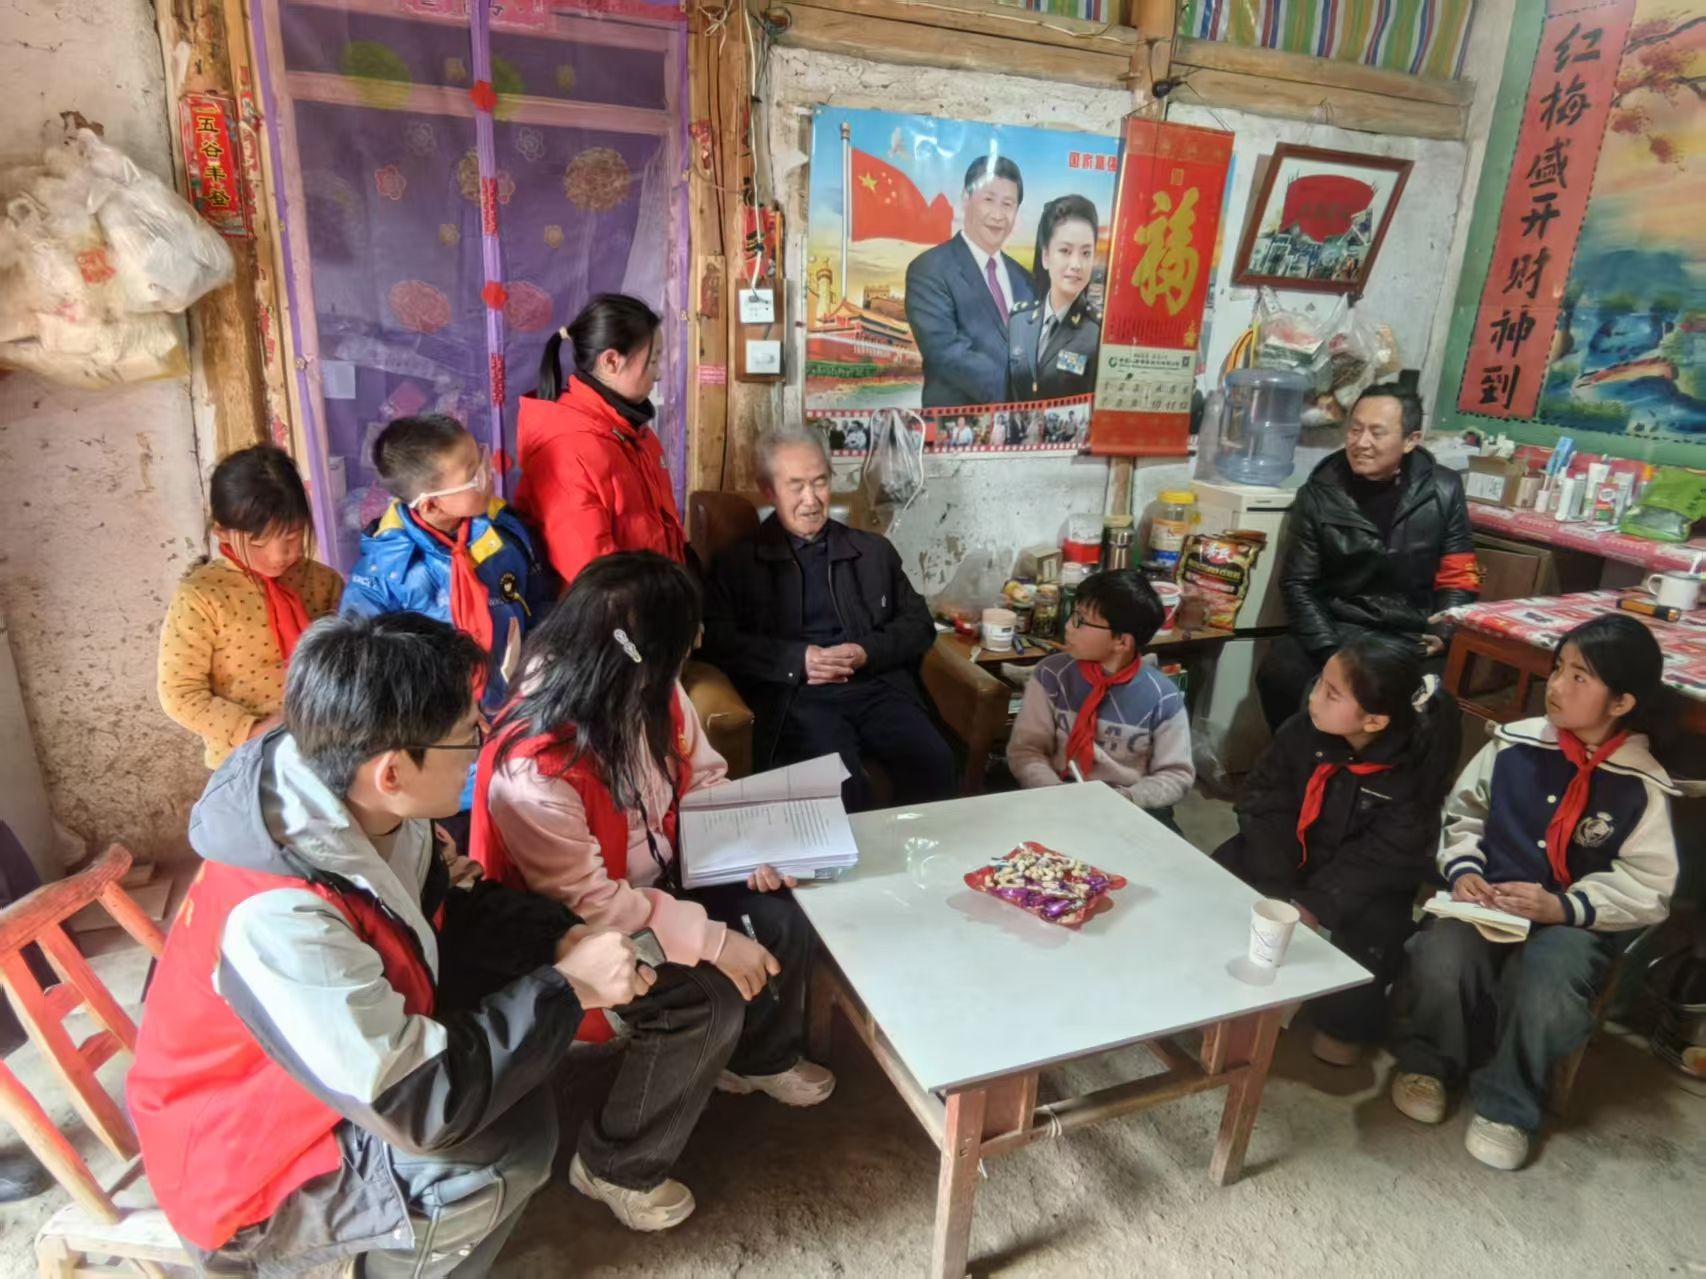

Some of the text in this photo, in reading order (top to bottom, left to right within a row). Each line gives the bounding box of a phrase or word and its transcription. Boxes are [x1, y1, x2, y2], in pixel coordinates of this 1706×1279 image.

[198, 116, 230, 206] 五谷丰登
[1479, 22, 1604, 410] 红梅盛开财神到
[1131, 186, 1200, 317] 福
